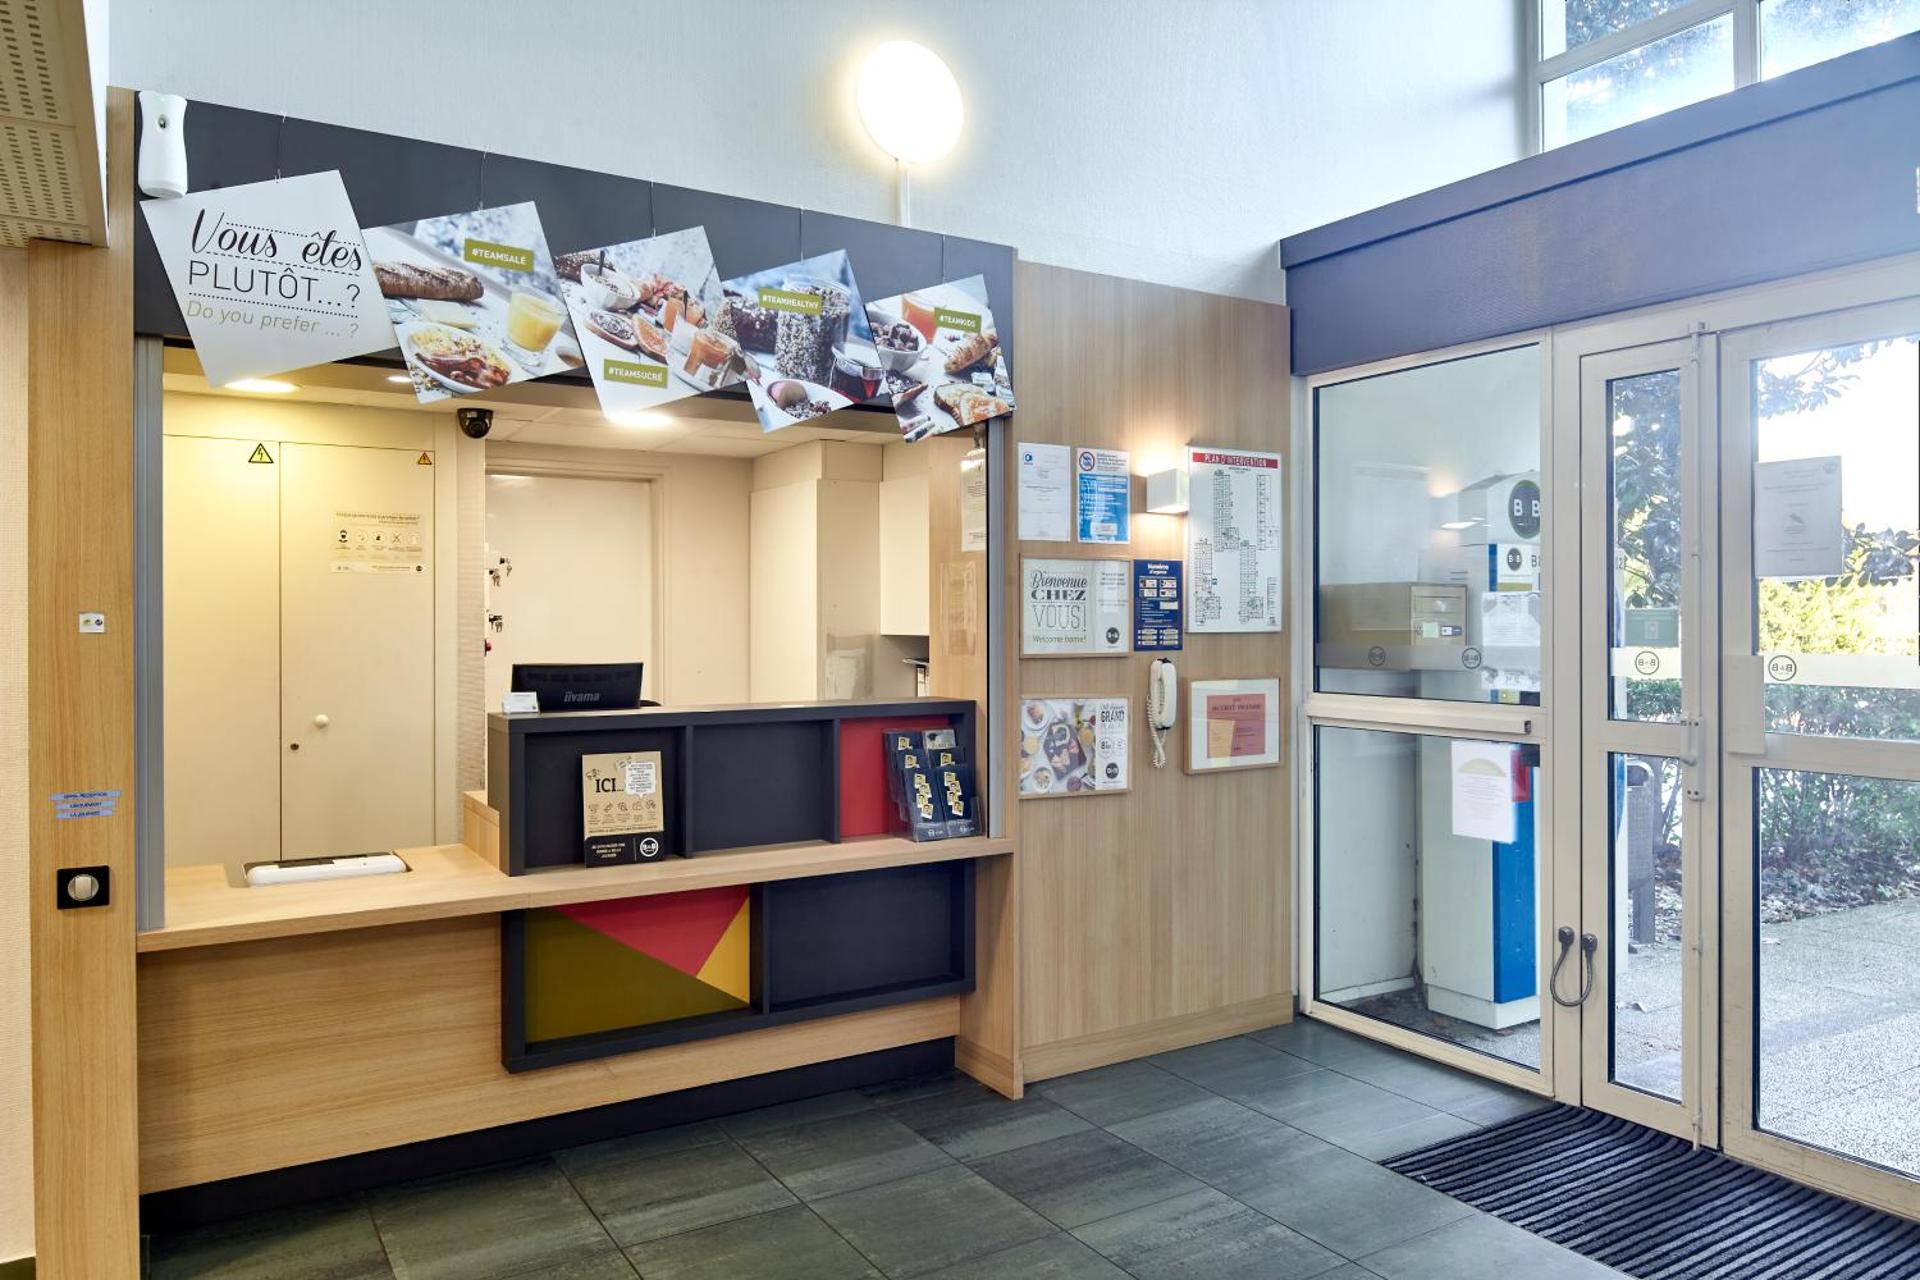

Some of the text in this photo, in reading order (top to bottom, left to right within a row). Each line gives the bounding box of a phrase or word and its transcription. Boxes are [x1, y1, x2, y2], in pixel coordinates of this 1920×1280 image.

[191, 208, 362, 271] Vous êtes
[762, 294, 819, 309] #TEAMHEALTHY
[187, 300, 213, 319] Do
[220, 307, 254, 325] you
[260, 313, 319, 335] prefer
[938, 314, 976, 328] #TEAMKIDS
[1204, 453, 1219, 464] PLAN
[1031, 569, 1087, 588] Bienvenue
[1031, 589, 1086, 601] CHEZ
[1032, 634, 1064, 644] Welcome
[564, 691, 600, 703] iiyama
[1100, 710, 1125, 722] GRAND
